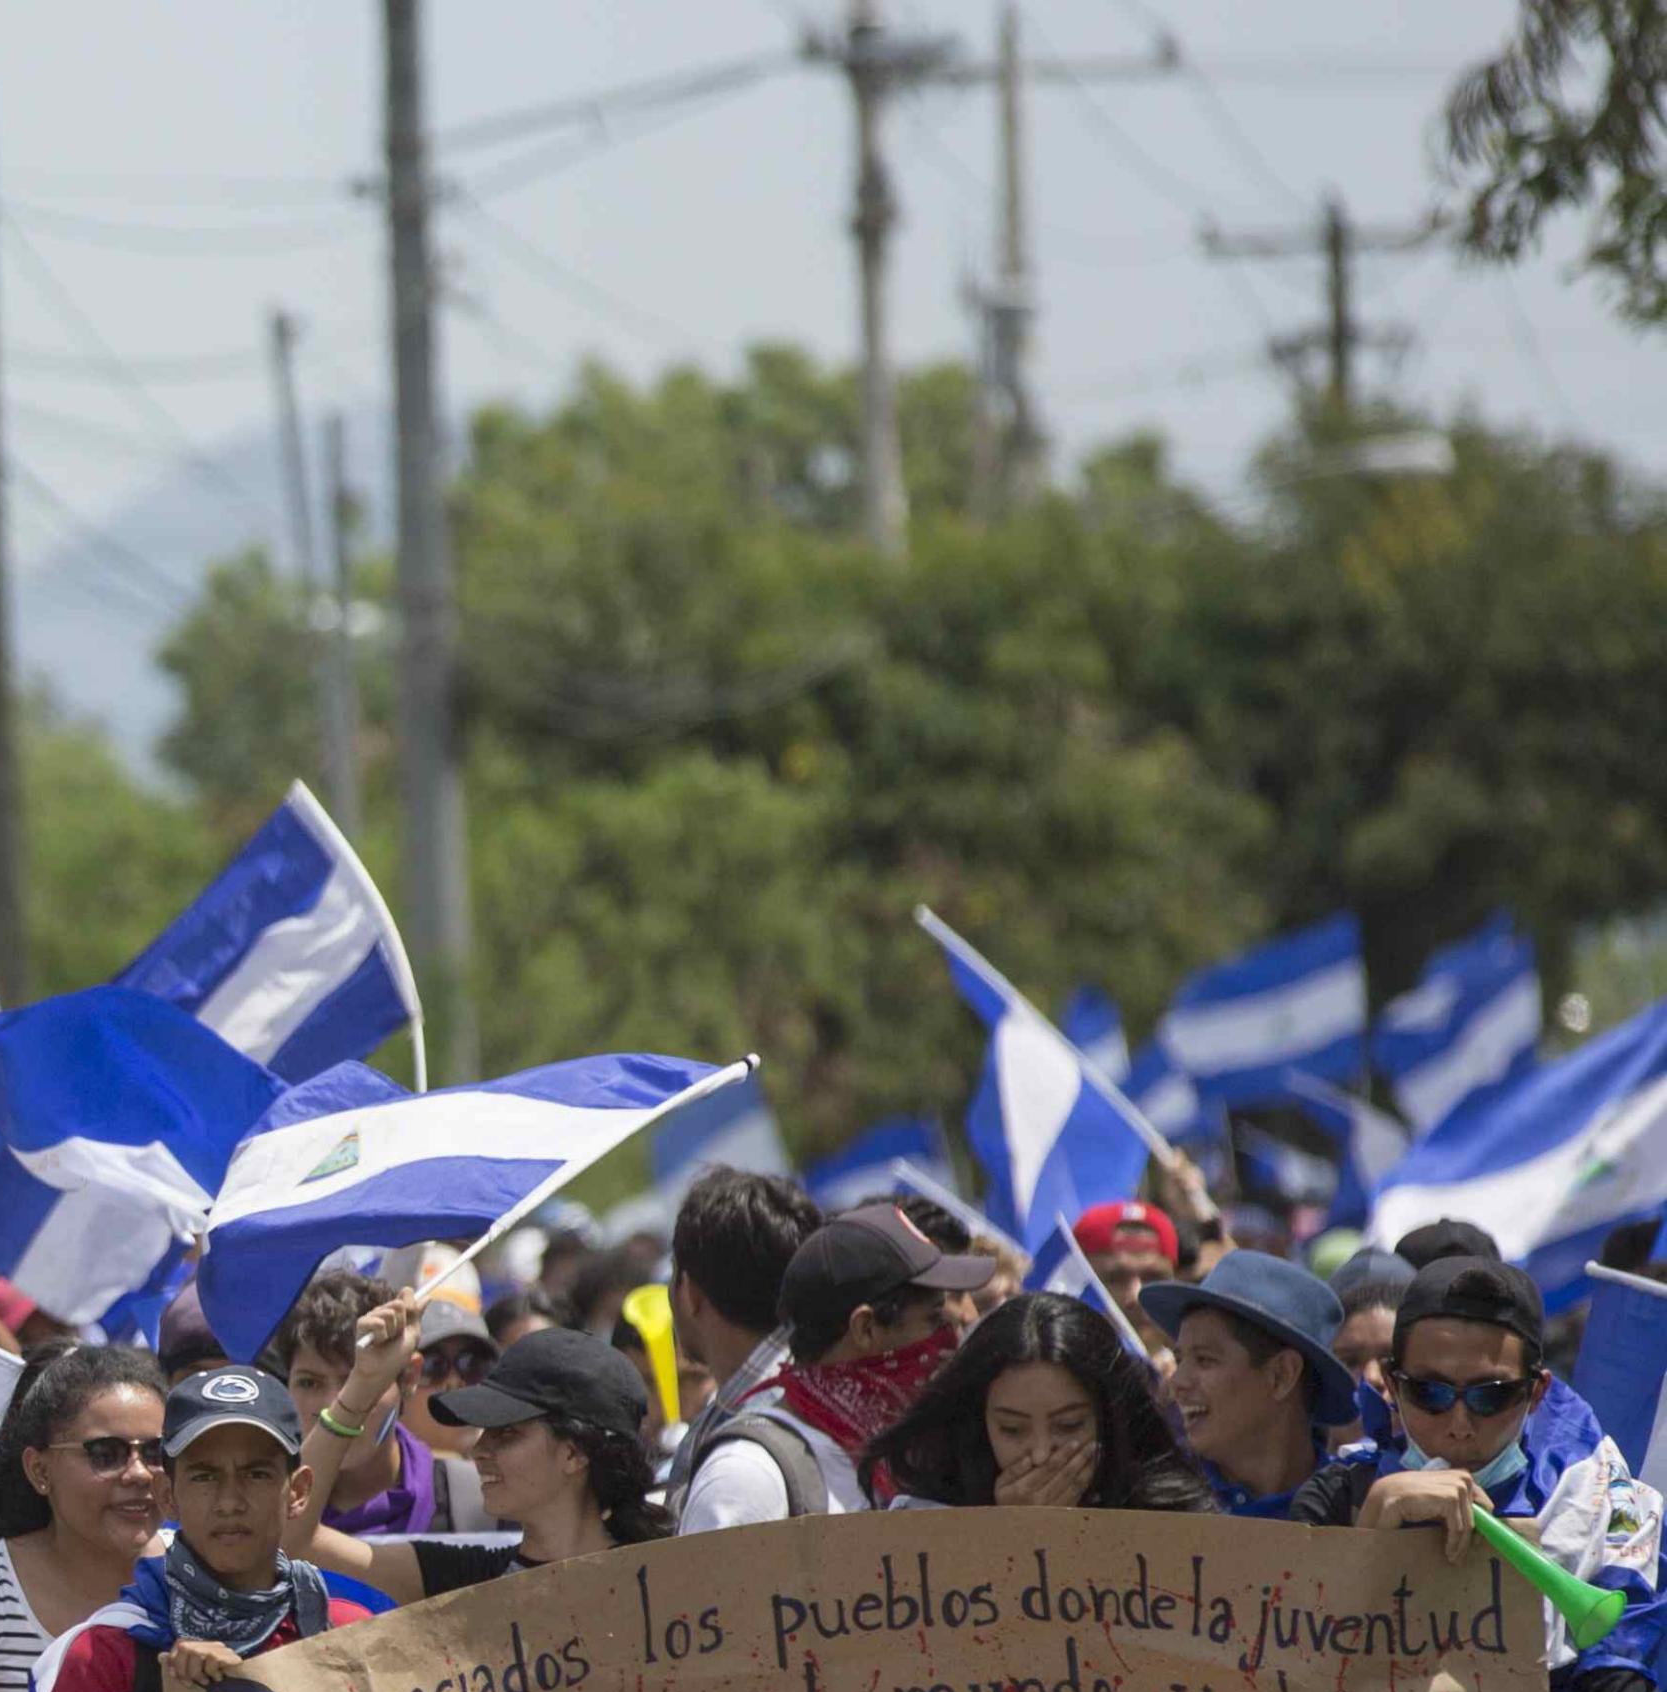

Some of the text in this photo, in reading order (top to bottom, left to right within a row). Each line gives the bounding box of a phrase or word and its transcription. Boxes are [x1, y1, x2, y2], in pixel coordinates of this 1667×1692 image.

[637, 1565, 723, 1663] los
[772, 1552, 998, 1669] pueblos
[1239, 1558, 1507, 1672] juventud
